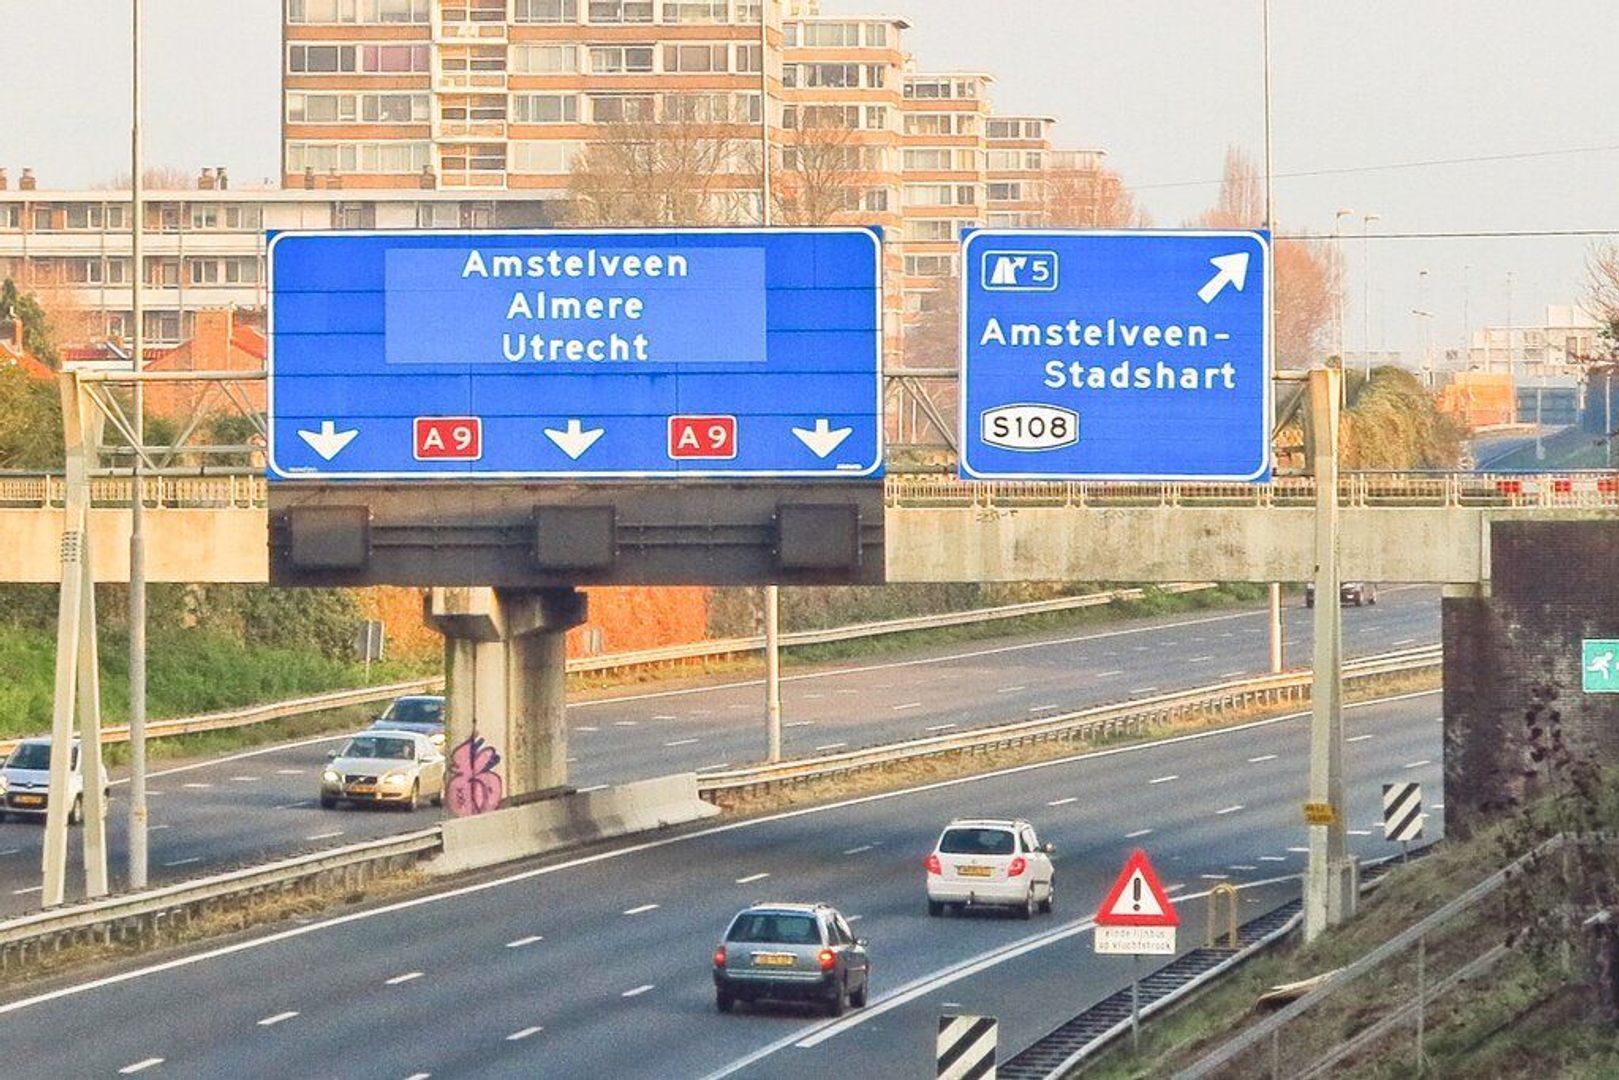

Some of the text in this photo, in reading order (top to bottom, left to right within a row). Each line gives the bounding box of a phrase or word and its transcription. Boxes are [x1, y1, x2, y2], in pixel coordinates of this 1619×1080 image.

[462, 249, 688, 278] Amstelveen
[1032, 260, 1050, 282] 5
[506, 292, 644, 320] Almere
[980, 318, 1230, 347] Amstelveen-
[502, 334, 649, 362] Utrecht
[1044, 360, 1236, 389] Stadshart
[992, 416, 1068, 439] S108
